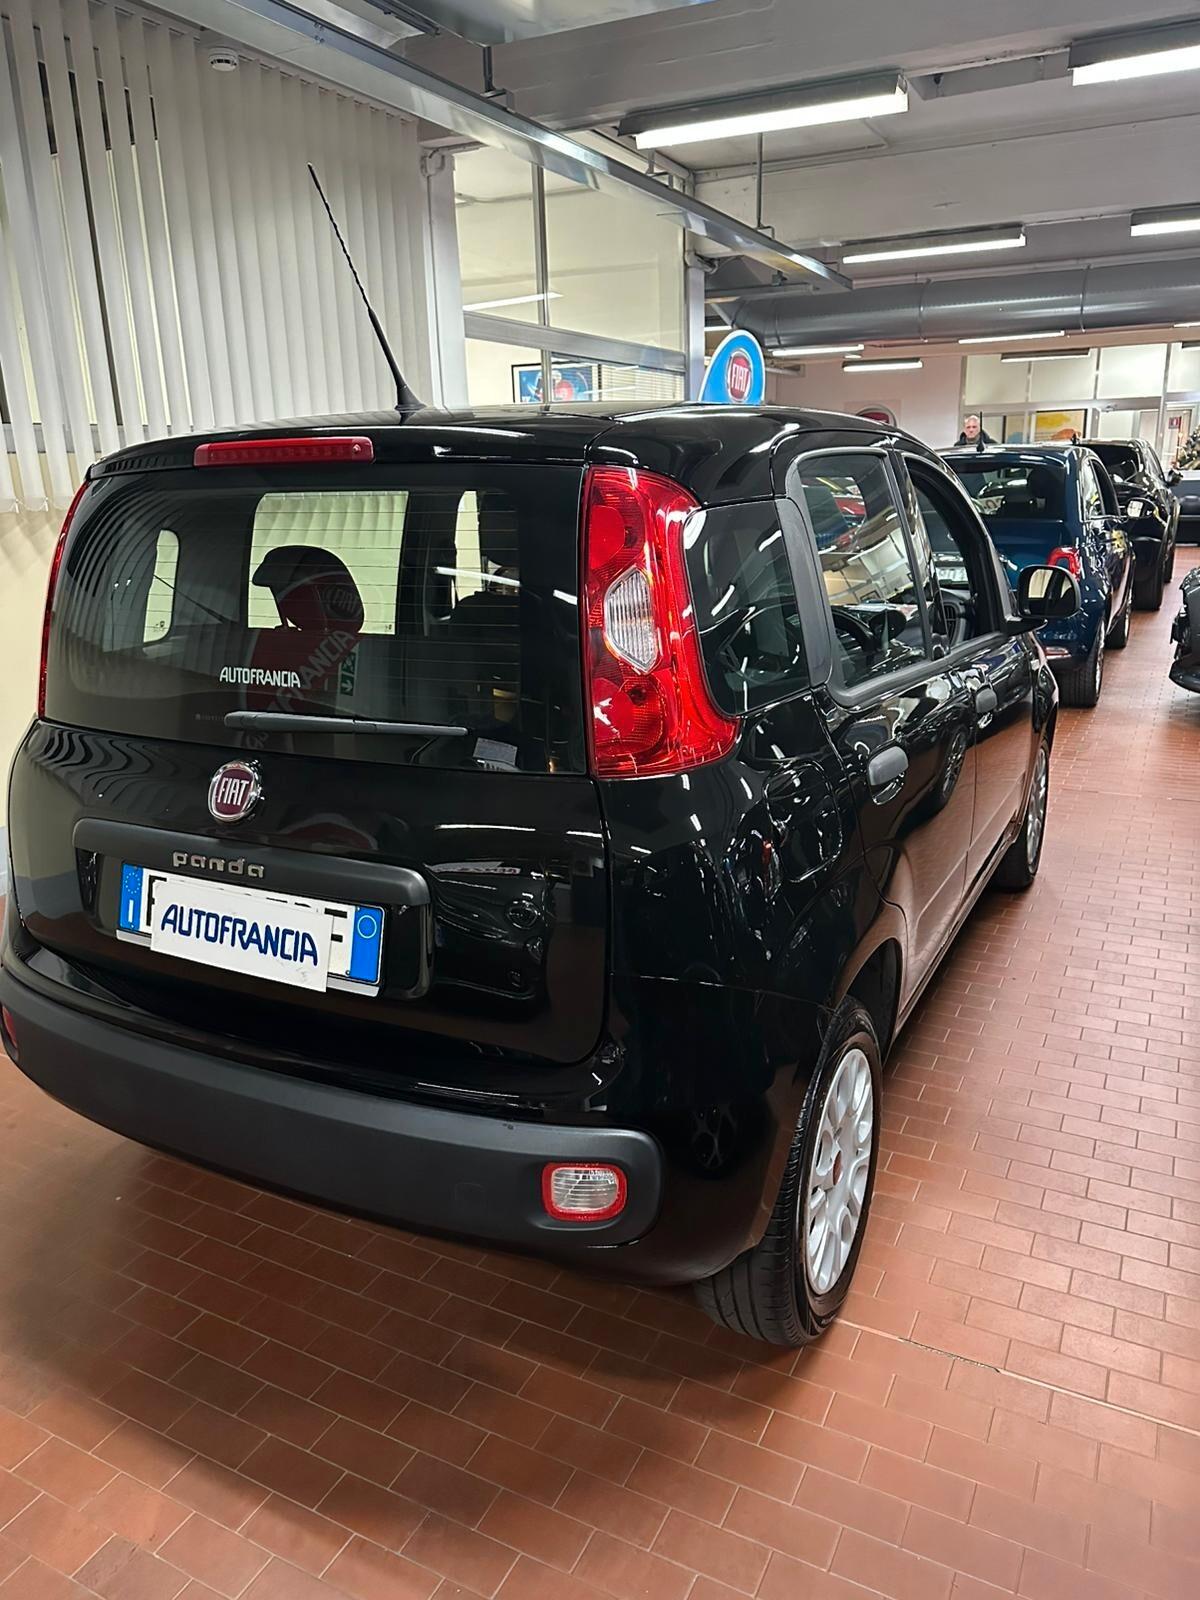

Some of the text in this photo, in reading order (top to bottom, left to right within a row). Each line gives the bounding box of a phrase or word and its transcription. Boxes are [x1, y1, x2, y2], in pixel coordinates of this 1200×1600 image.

[731, 363, 749, 393] FIAT
[219, 667, 301, 689] AUTOFRANCIA
[217, 777, 250, 806] FIAT
[172, 851, 265, 878] panda
[160, 903, 319, 967] AUTOFRANCIA
